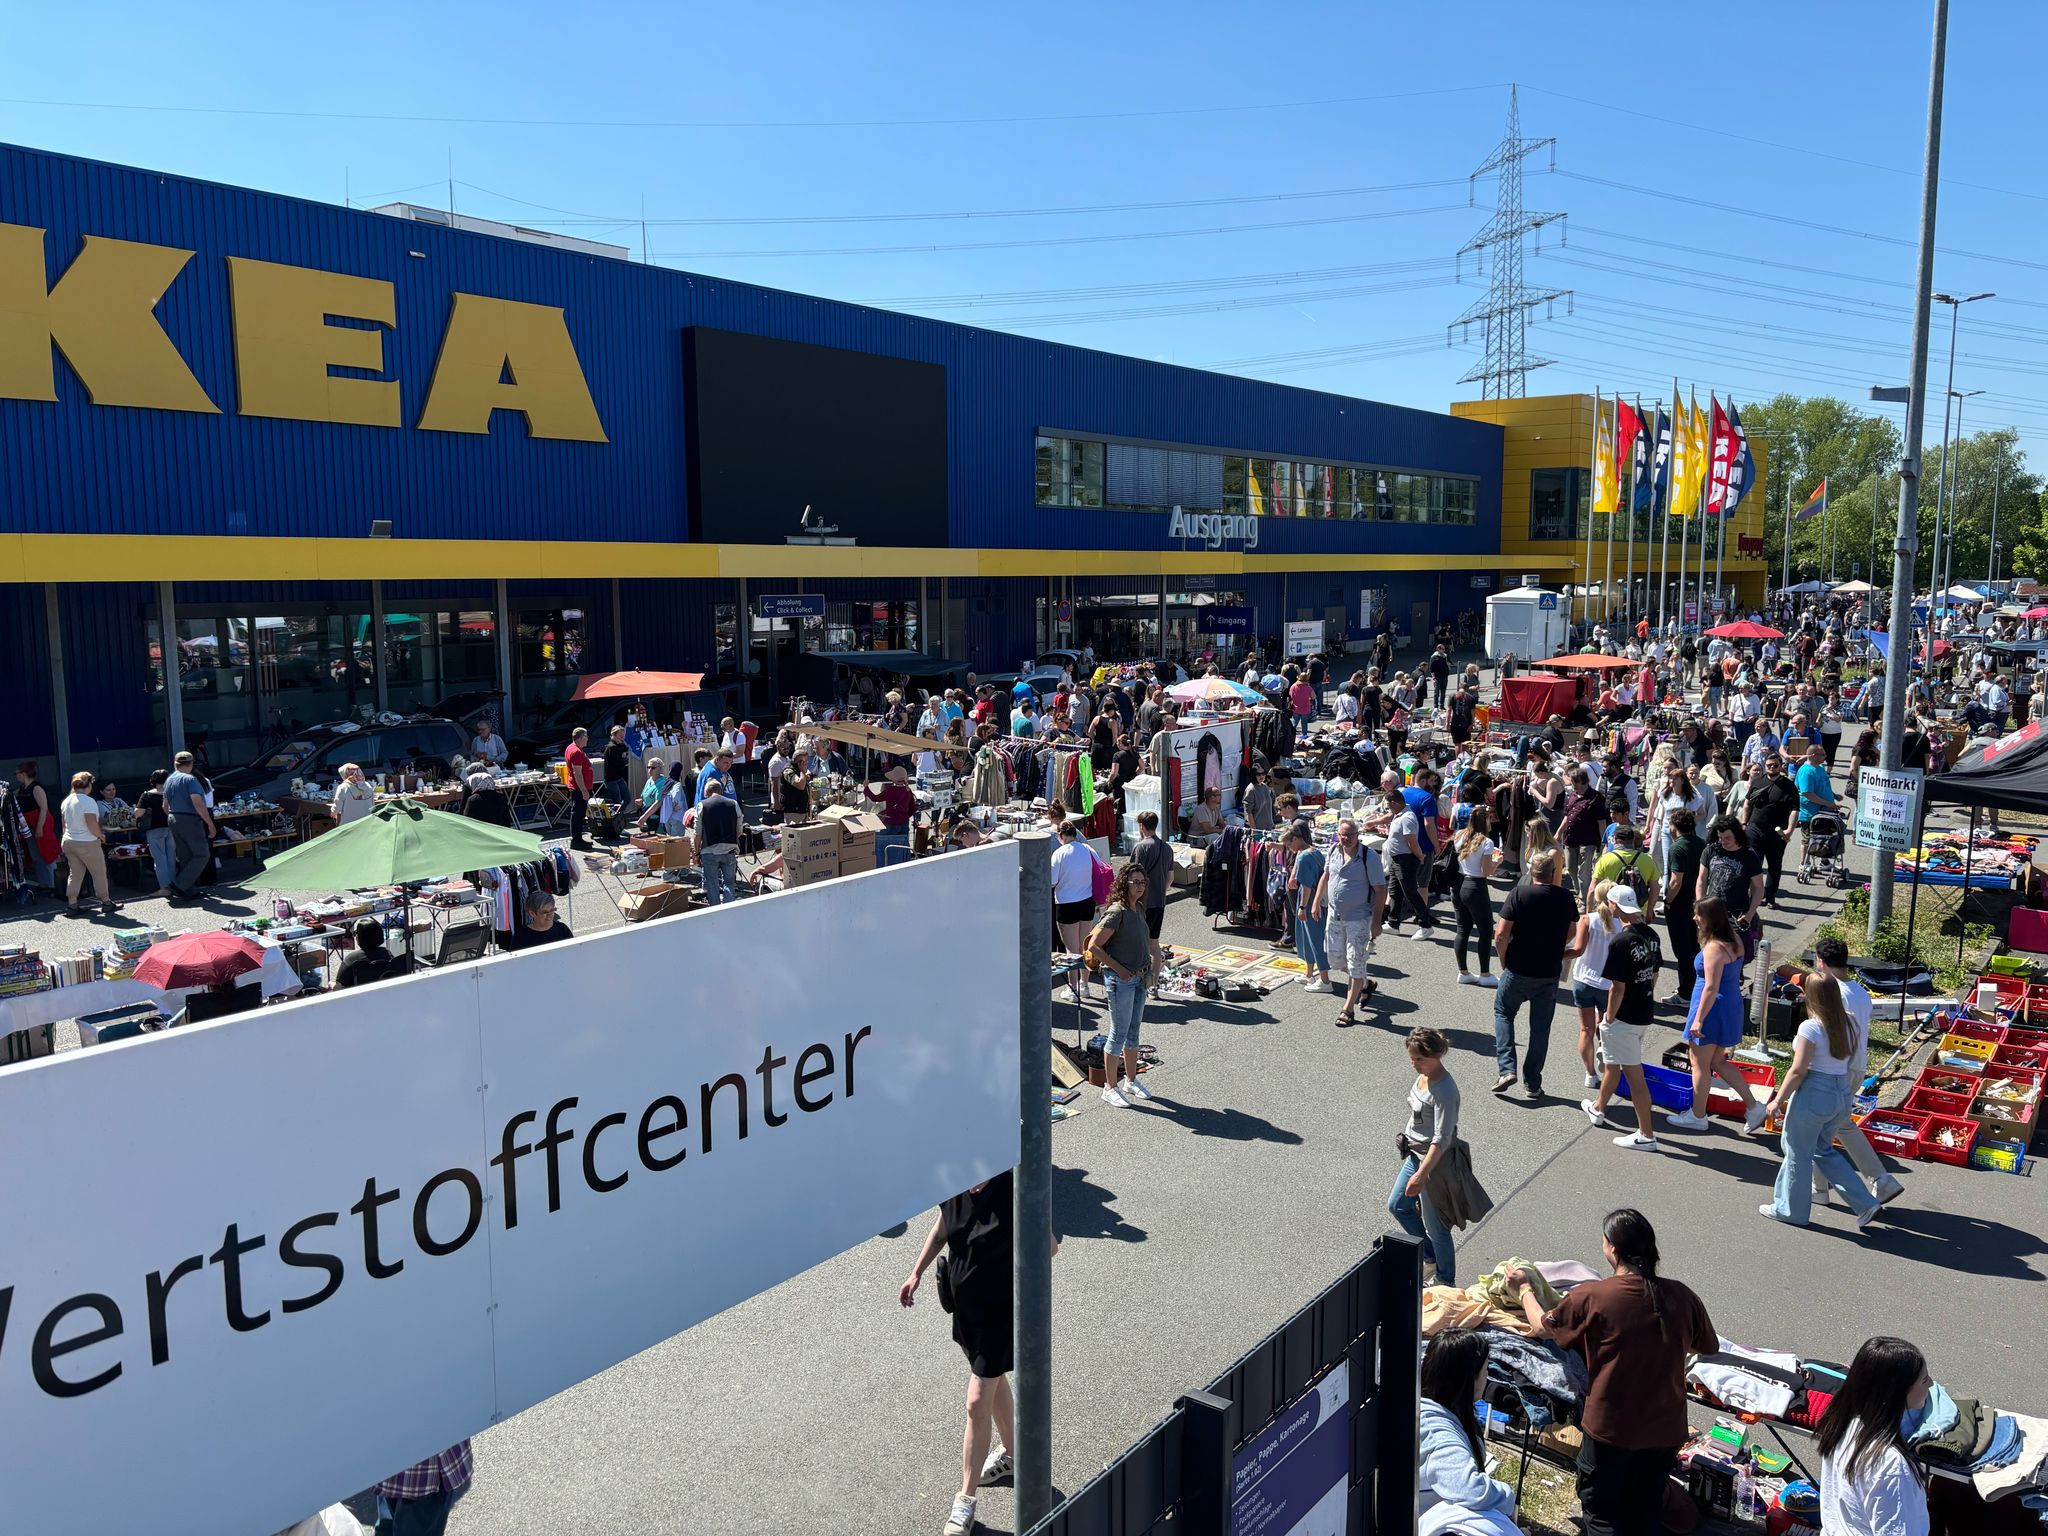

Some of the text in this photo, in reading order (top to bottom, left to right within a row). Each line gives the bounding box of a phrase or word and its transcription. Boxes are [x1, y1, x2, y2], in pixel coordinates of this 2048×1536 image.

[1707, 419, 1730, 505] IKEA
[1168, 505, 1258, 548] Ausgang
[1218, 616, 1247, 626] Eingang
[1861, 772, 1916, 791] Flohmarkt
[1872, 795, 1904, 807] Sonntag
[1858, 819, 1910, 836] Halle (Westf.)
[1860, 829, 1905, 845] OWL Arena
[810, 839, 832, 847] ACTION
[0, 1025, 872, 1398] ertstoffcenter
[1236, 1410, 1310, 1482] Papier, Pappe, Kartonage
[1236, 1473, 1251, 1494] (Sorte
[1238, 1489, 1261, 1514] Zeitungen
[1788, 1523, 1820, 1536] NIK
